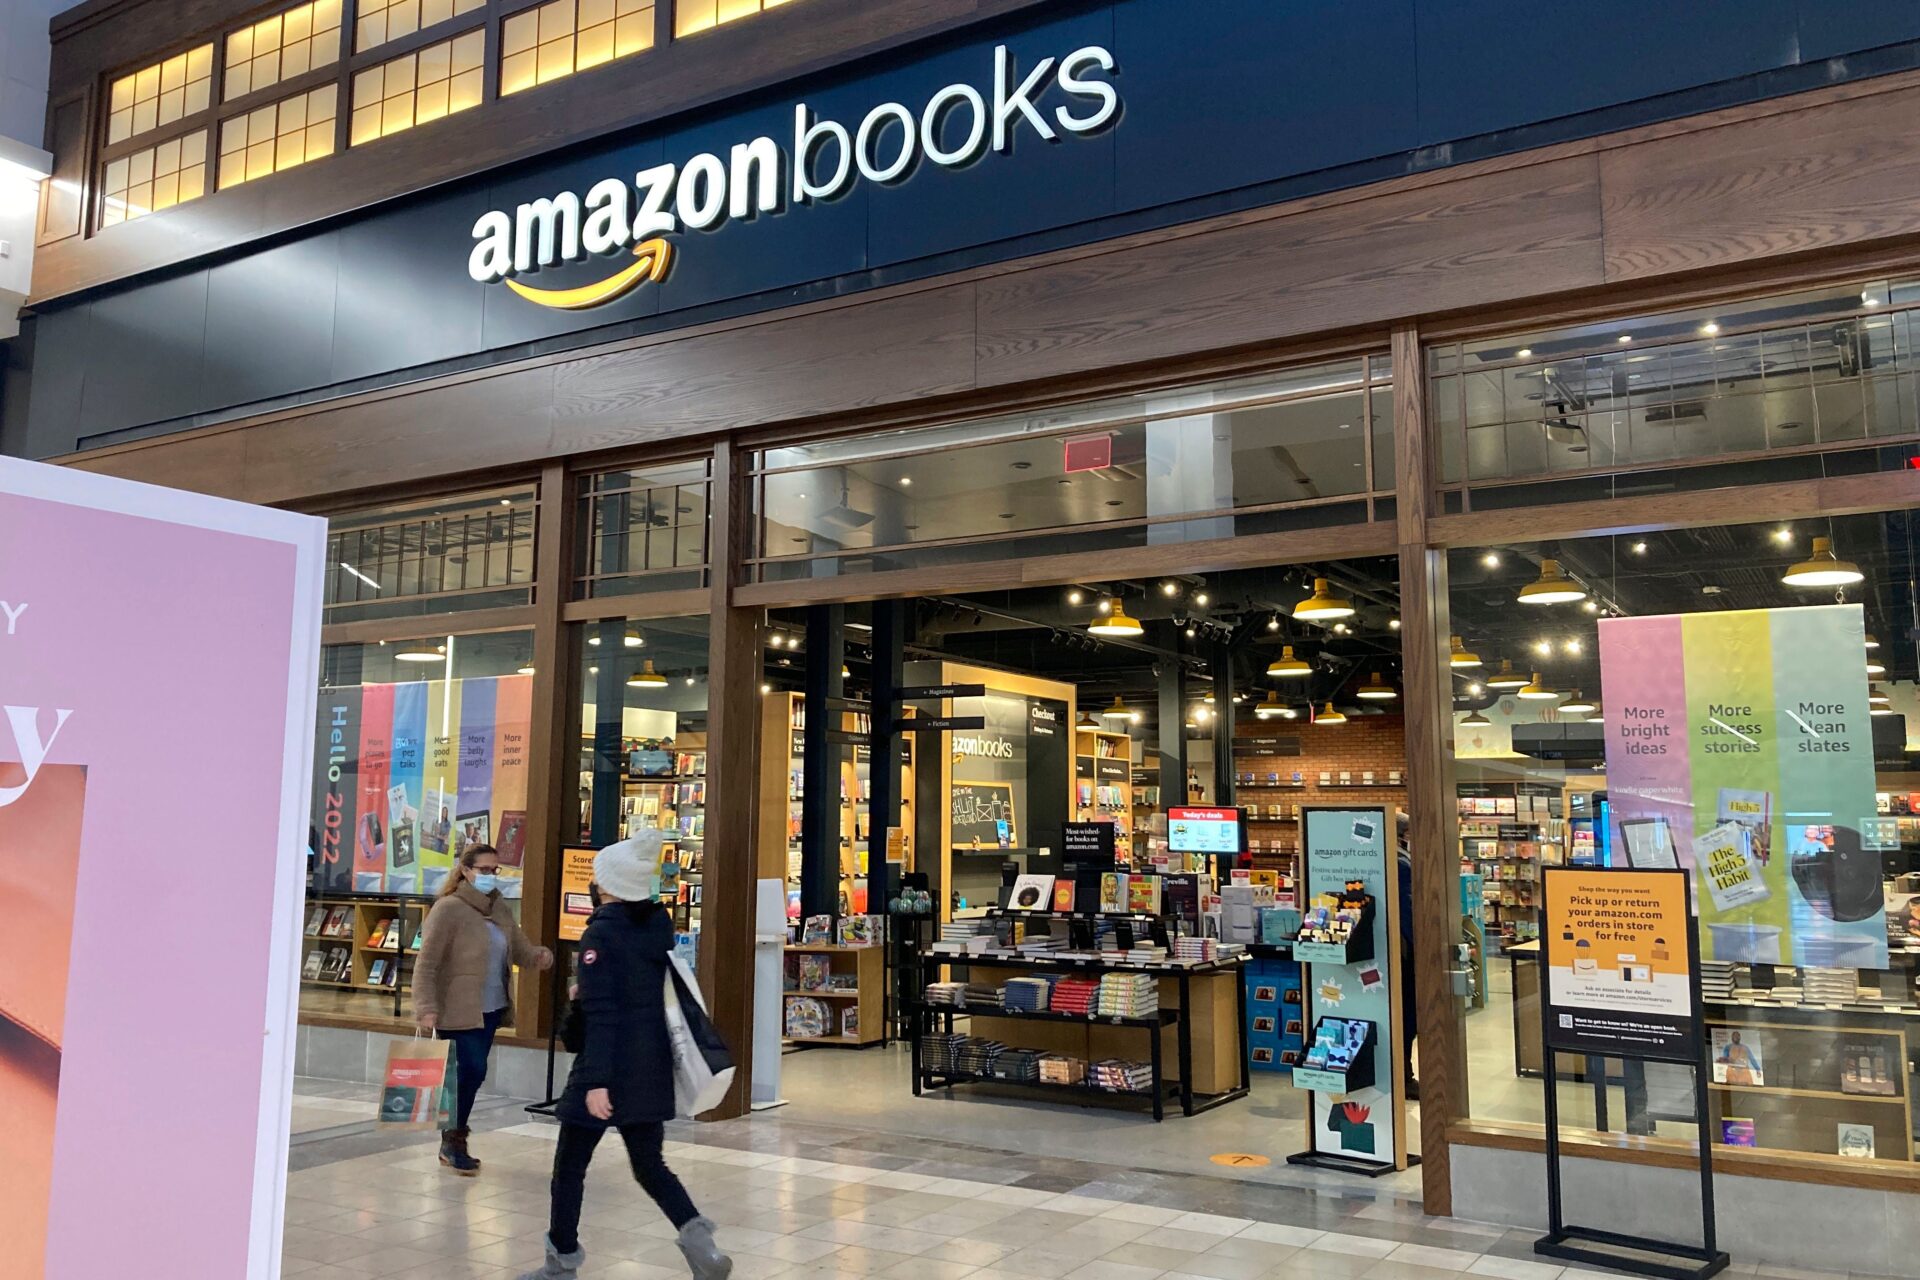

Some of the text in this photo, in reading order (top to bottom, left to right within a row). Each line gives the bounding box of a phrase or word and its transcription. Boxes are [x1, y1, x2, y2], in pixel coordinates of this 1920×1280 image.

[1624, 706, 1665, 719] More
[1709, 704, 1752, 717] More
[1799, 702, 1845, 715] More
[1621, 723, 1670, 740] bright
[1700, 722, 1763, 736] success
[468, 735, 486, 744] More
[504, 733, 522, 743] More
[467, 745, 485, 756] belly
[503, 744, 521, 754] inner
[1625, 741, 1667, 755] ideas
[1704, 740, 1761, 754] stories
[1798, 739, 1850, 753] slates
[402, 749, 415, 758] pep
[434, 748, 450, 758] good
[399, 760, 416, 768] talks
[434, 759, 448, 768] eats
[464, 758, 487, 768] laughs
[501, 757, 522, 767] peace
[322, 706, 348, 865] Hello 2022
[1729, 801, 1760, 813] High 5
[1182, 811, 1223, 819] Today's deals
[1342, 848, 1356, 857] gift
[1357, 849, 1378, 857] cards
[1712, 847, 1734, 862] The
[1708, 854, 1747, 878] High 5
[1716, 869, 1750, 891] Habit
[1101, 902, 1120, 912] WILL
[1570, 896, 1592, 905] Pick
[1595, 899, 1608, 907] up
[1625, 899, 1660, 908] return
[1568, 909, 1663, 919] your amazon.com
[1577, 919, 1655, 931] orders in store
[1595, 930, 1636, 941] for free
